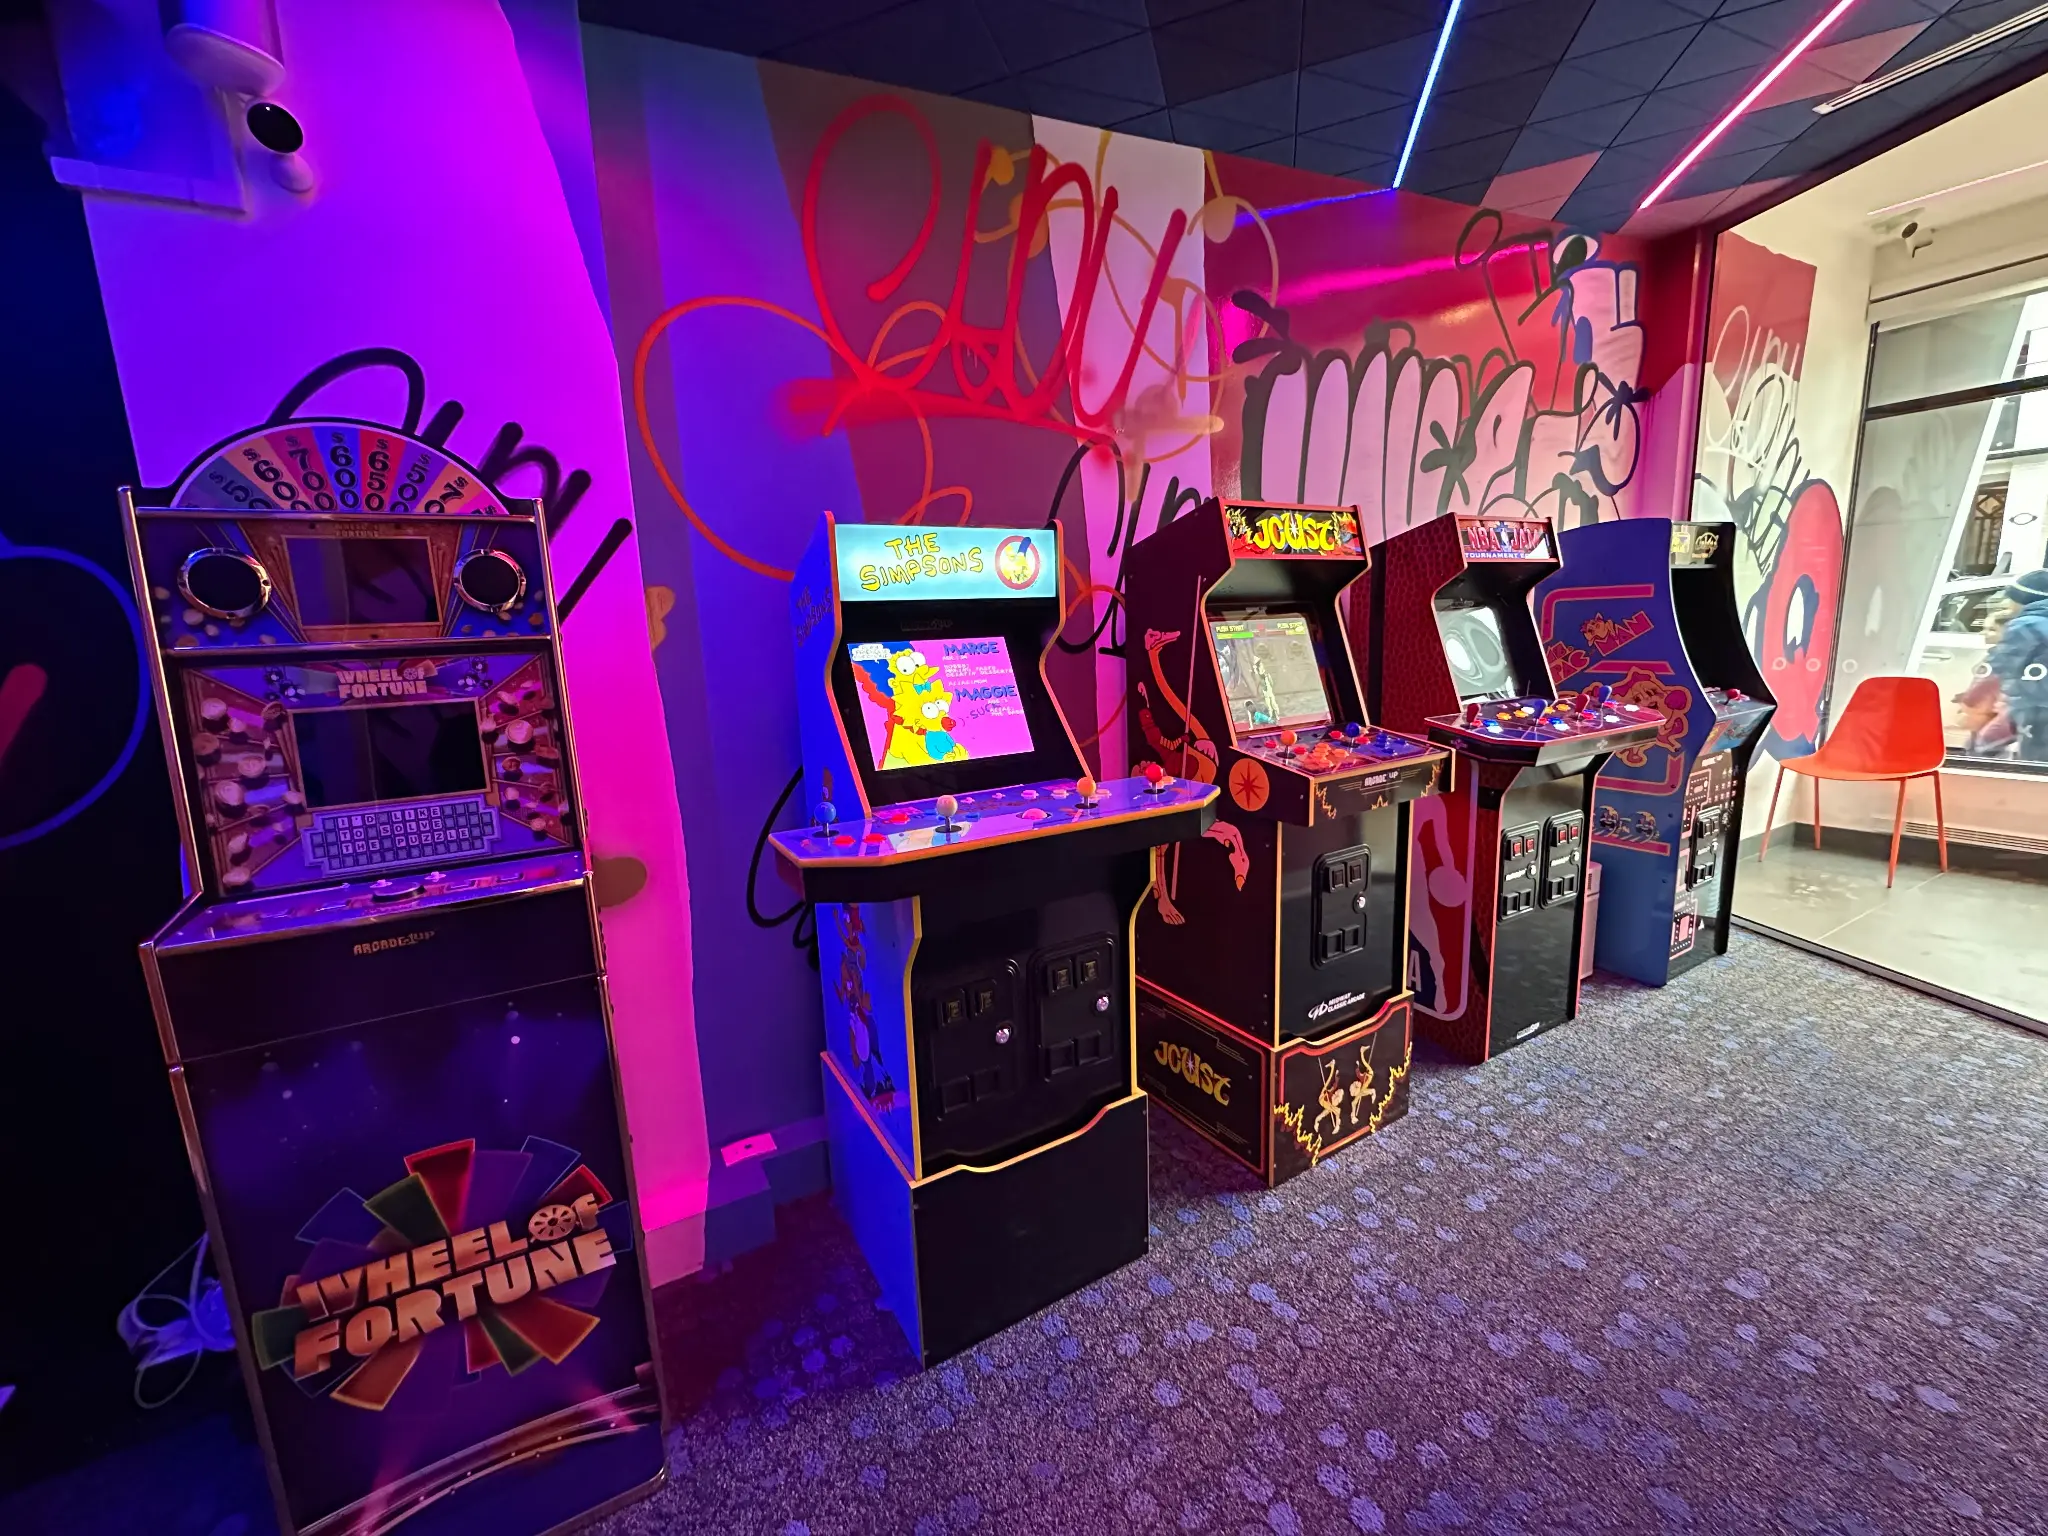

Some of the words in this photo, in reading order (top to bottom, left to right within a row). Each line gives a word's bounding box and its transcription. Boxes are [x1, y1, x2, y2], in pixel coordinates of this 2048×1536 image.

[285, 435, 336, 511] $700
[330, 432, 360, 509] $600
[364, 439, 390, 512] $650
[1253, 512, 1335, 551] JOUST
[1467, 526, 1501, 550] NBA
[1510, 528, 1543, 550] JAM
[884, 532, 941, 560] THE
[859, 547, 984, 592] SIMPSONS
[943, 641, 1000, 656] MARGE
[336, 669, 402, 684] WHEEL
[338, 681, 428, 698] FORTUNE
[955, 685, 1018, 702] MAGGIE
[392, 806, 441, 822] LIKE
[340, 828, 365, 840] TO
[381, 820, 442, 835] SOLVE
[343, 841, 379, 854] THE
[396, 829, 469, 846] PUZZLE
[1154, 1039, 1233, 1106] JOUST
[296, 1220, 530, 1323] WHEEL
[293, 1228, 618, 1381] FORTUNE
